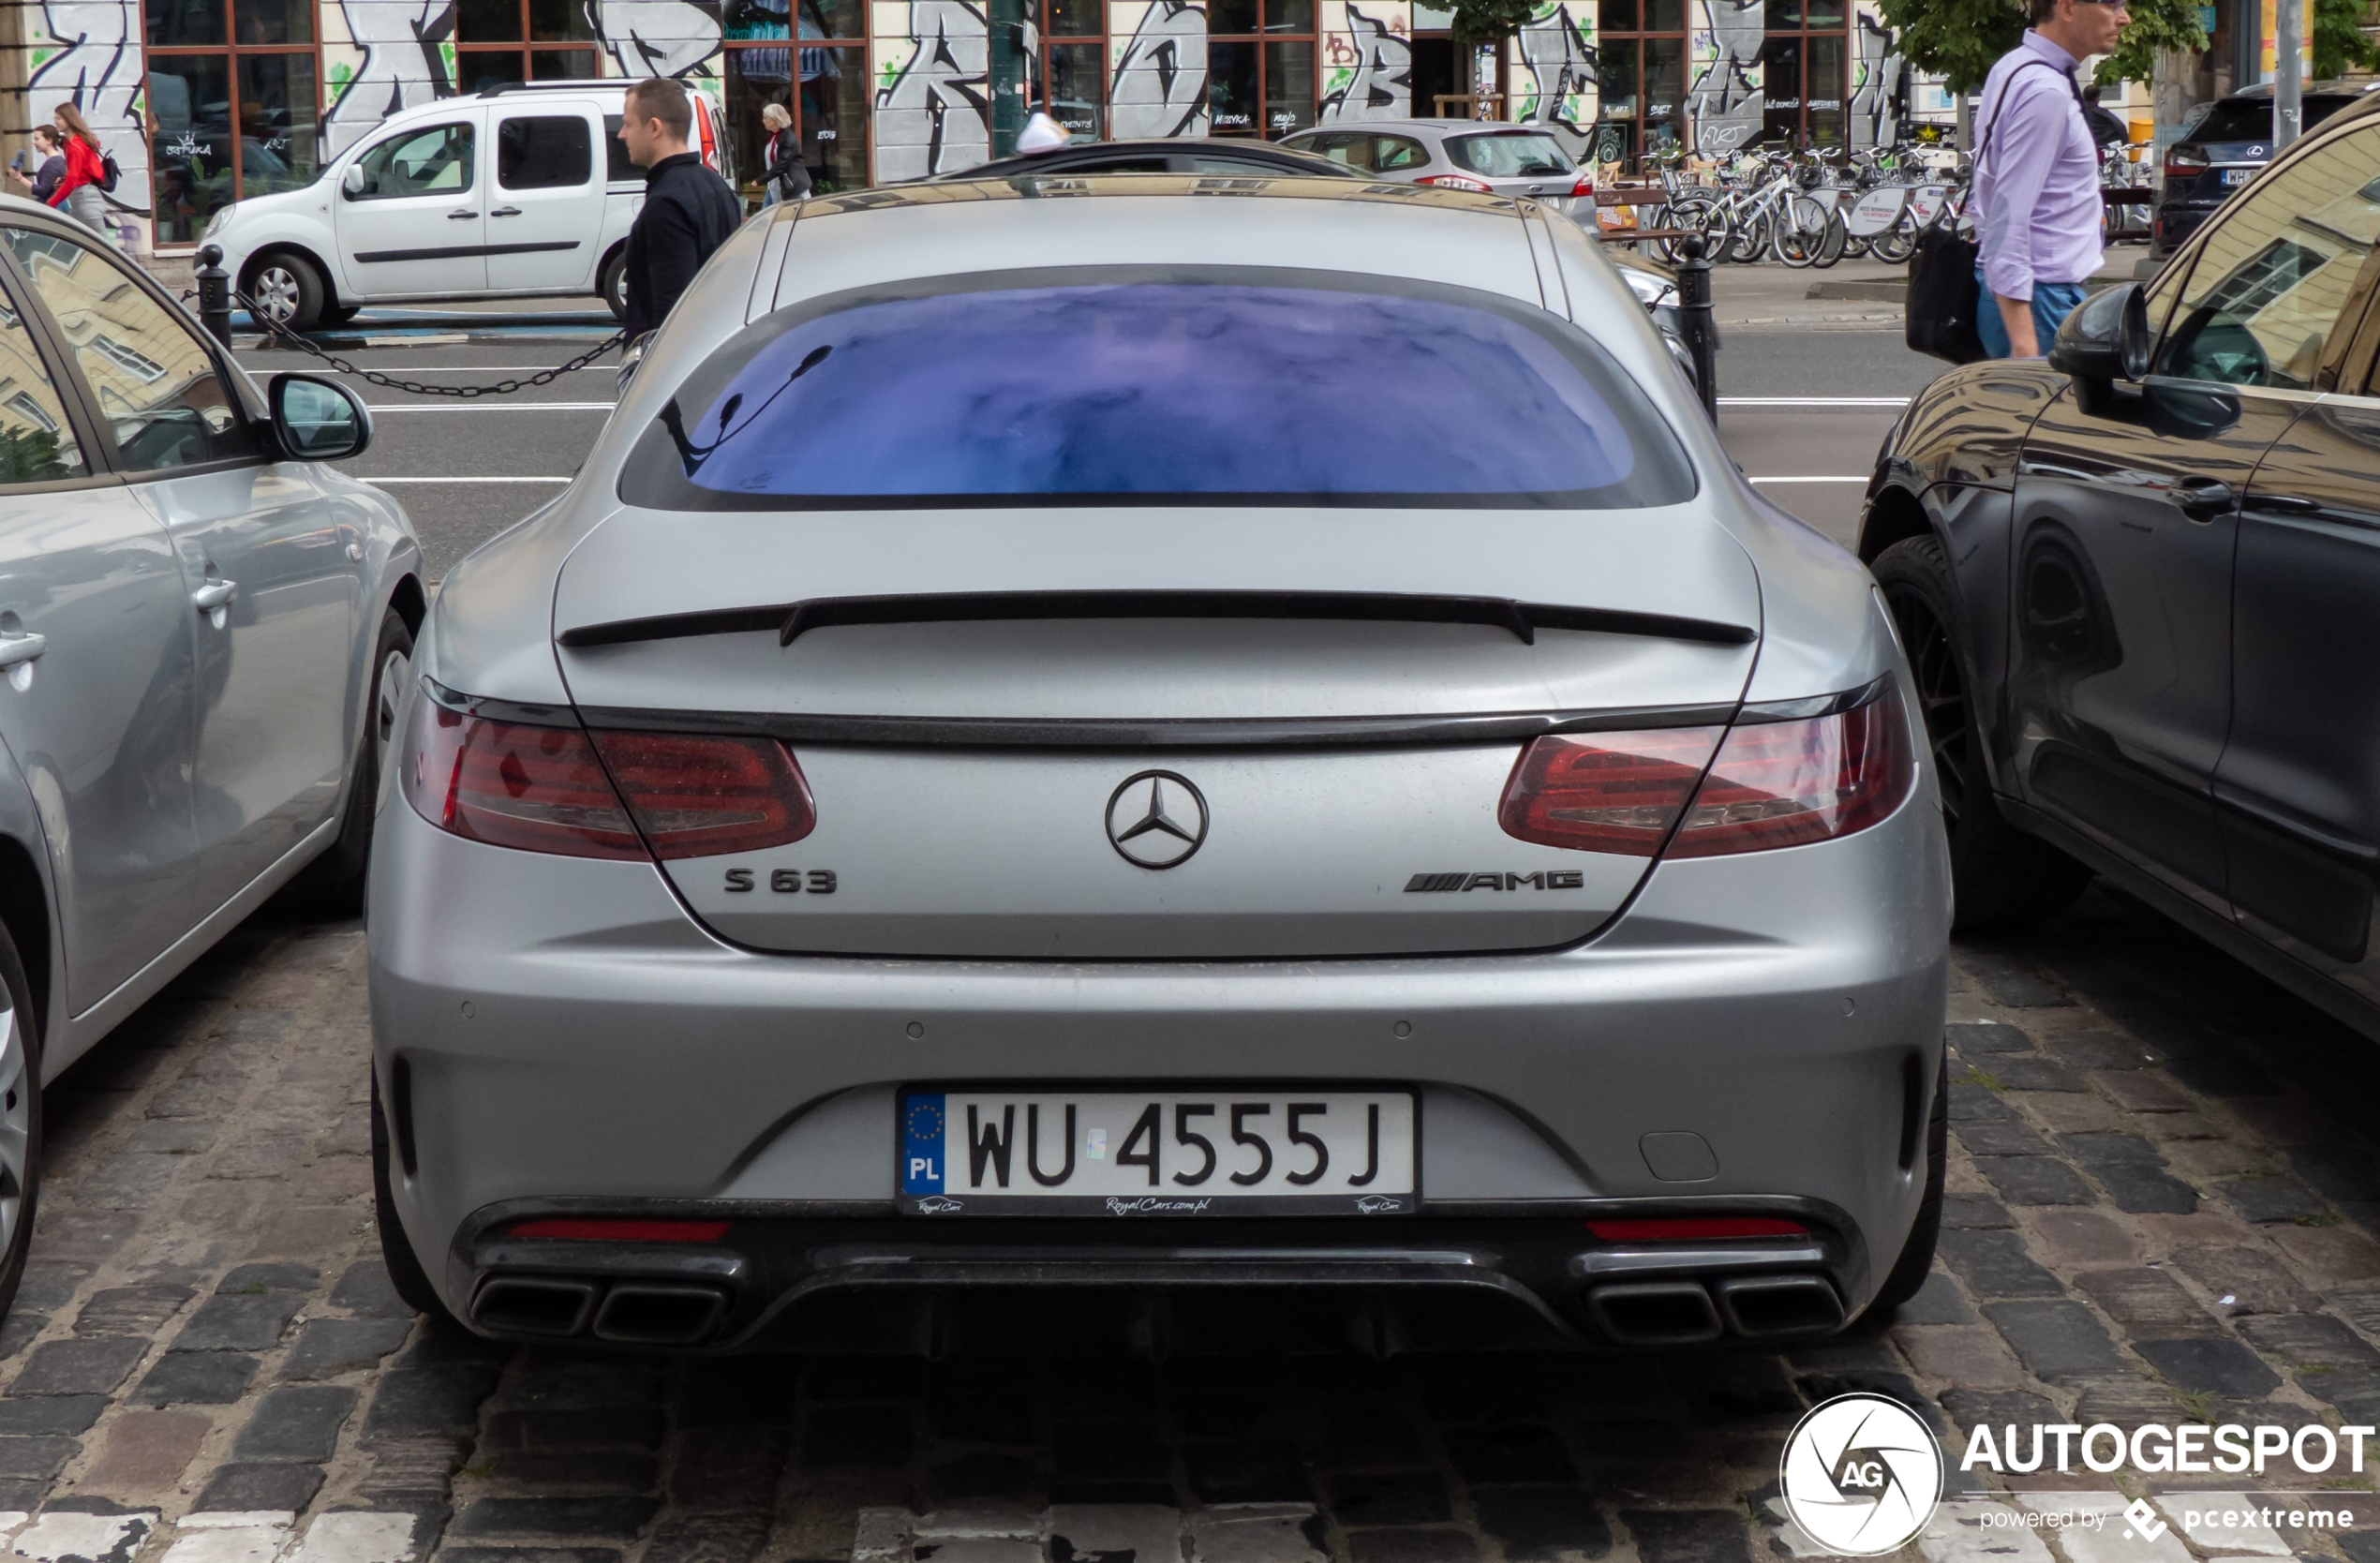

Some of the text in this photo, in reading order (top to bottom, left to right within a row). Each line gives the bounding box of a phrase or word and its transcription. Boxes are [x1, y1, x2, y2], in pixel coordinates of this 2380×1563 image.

[724, 868, 837, 893] S 63
[1461, 870, 1584, 891] AMG
[967, 1103, 1379, 1187] WU 4555J
[910, 1157, 940, 1180] PL
[919, 1202, 961, 1214] Royal Cars
[1358, 1201, 1380, 1213] Royal
